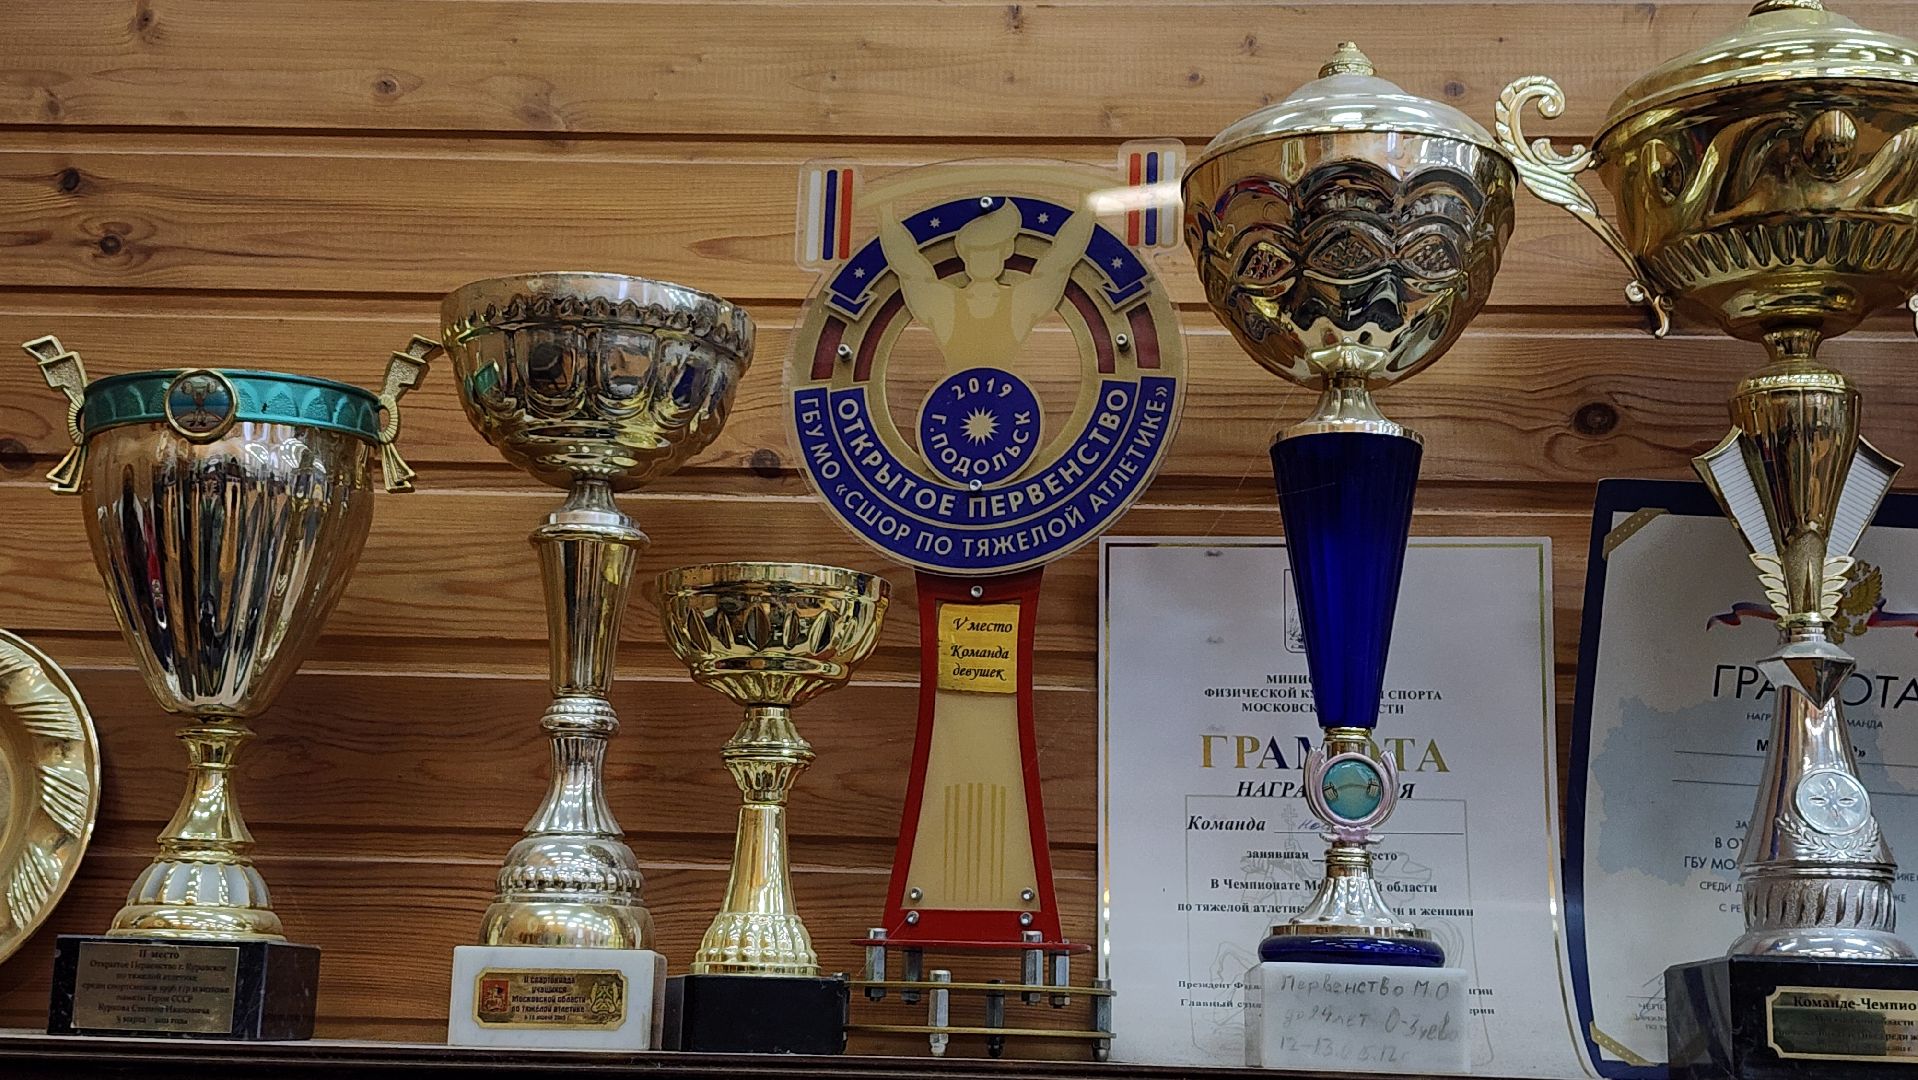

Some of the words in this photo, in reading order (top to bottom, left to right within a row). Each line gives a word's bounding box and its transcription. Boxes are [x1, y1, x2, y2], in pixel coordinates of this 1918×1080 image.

[951, 377, 1013, 401] 2019
[800, 397, 826, 438] ГБУ
[837, 398, 953, 518] ОТКРЫТОЕ
[968, 389, 1129, 519] ПЕРВЕНСТВО
[1089, 385, 1168, 512] АТЛЕТИКЕ»
[810, 442, 841, 480] МО
[836, 483, 910, 541] «СШОР
[961, 504, 1085, 559] ТЯЖЕЛОЙ
[919, 533, 953, 556] ПО
[967, 622, 1013, 633] место
[950, 645, 1010, 660] Команда
[952, 662, 1007, 681] девушек
[1204, 686, 1297, 700] ФИЗИЧЕСКОЙ
[1388, 690, 1443, 701] СПОРТА
[1200, 735, 1450, 773] ГРАТА
[1187, 815, 1266, 833] Команда
[1246, 849, 1310, 860] занявшая
[1371, 853, 1399, 862] есто
[1684, 855, 1707, 870] ГБУ
[1210, 878, 1219, 890] В
[1224, 879, 1301, 893] Чемпионате
[1386, 881, 1438, 894] области
[1699, 881, 1732, 893] СРЕДИ
[1177, 903, 1191, 913] по
[1195, 902, 1250, 914] тяжелой
[1420, 908, 1474, 917] женщин
[151, 950, 180, 960] место
[1178, 980, 1232, 990] Президент
[1280, 973, 1405, 1000] Первенство
[171, 995, 194, 1004] СССР
[1180, 998, 1234, 1008] Главный
